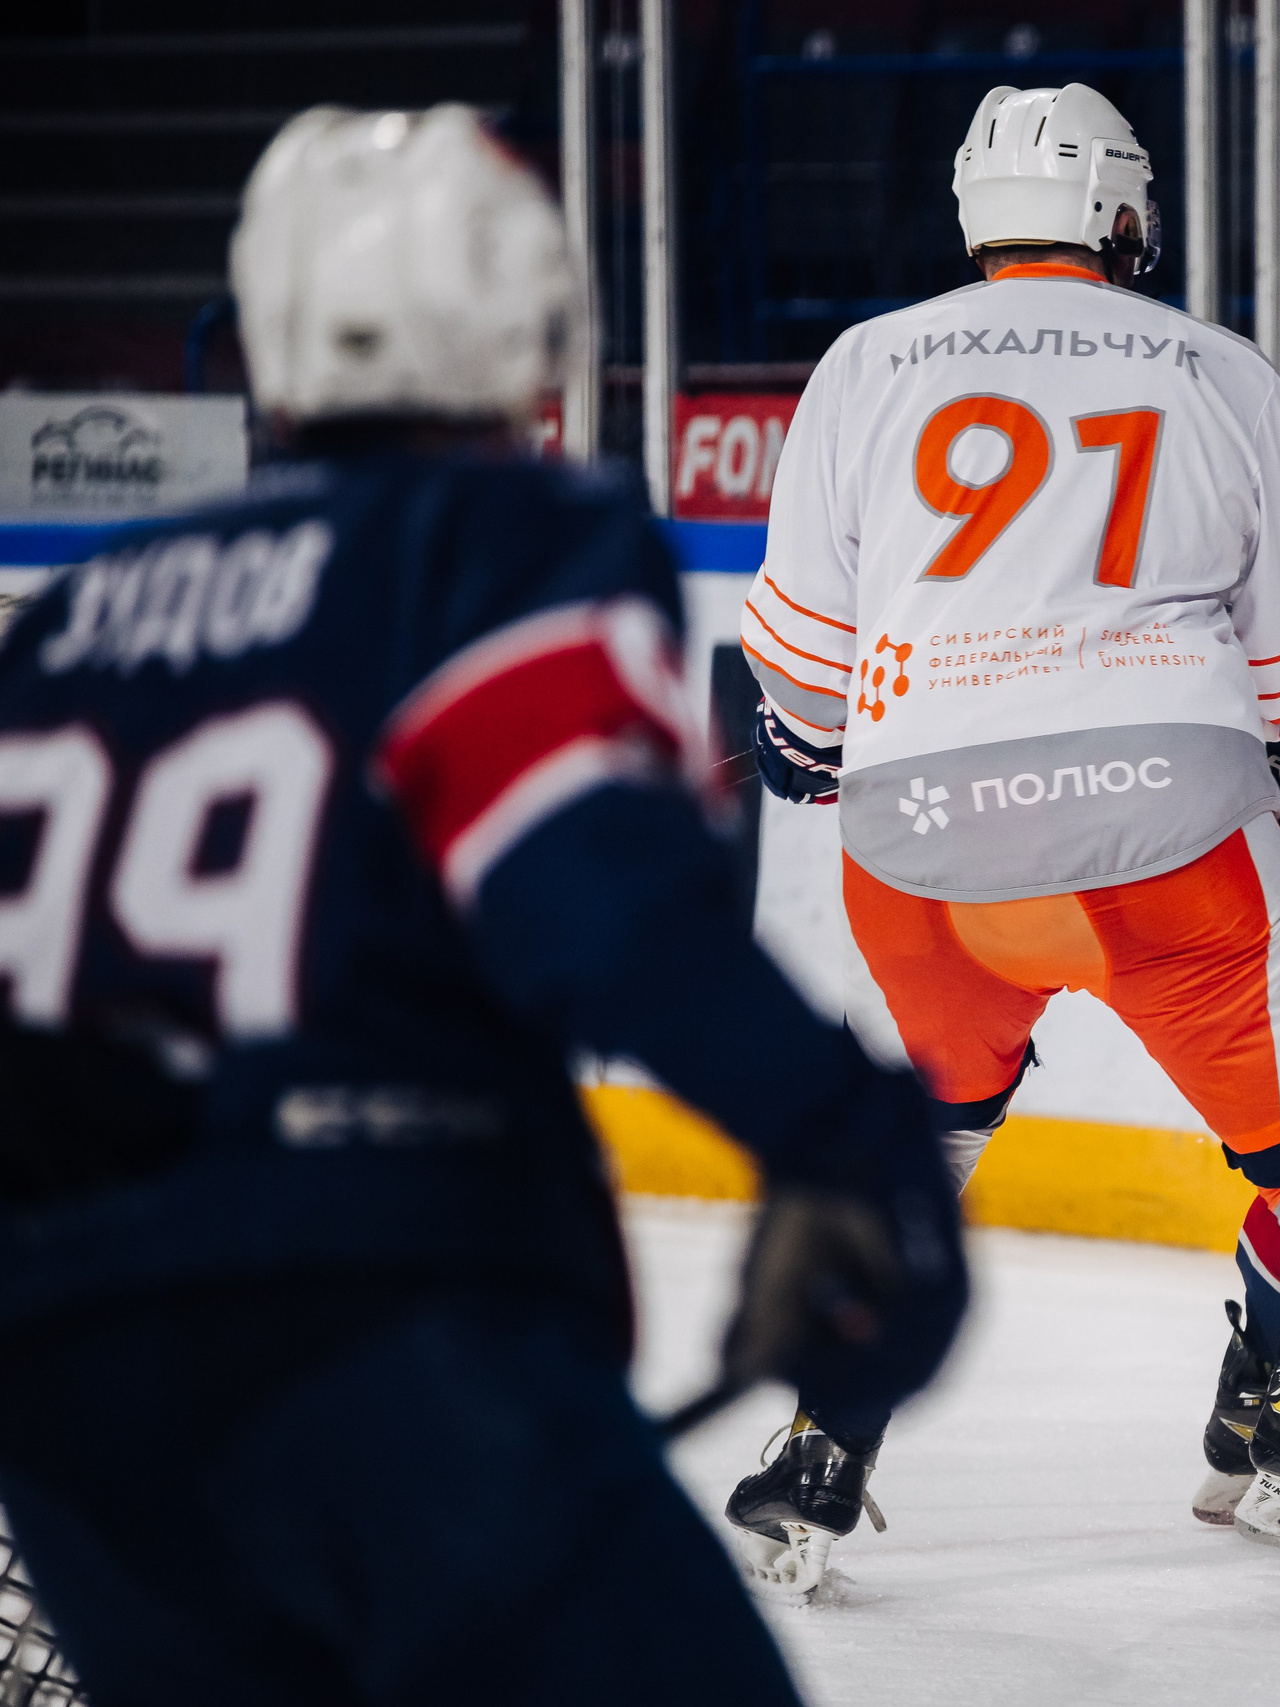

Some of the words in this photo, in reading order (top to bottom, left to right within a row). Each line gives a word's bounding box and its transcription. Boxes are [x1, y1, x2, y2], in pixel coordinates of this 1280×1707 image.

[890, 328, 1201, 381] МИХАЛЬЧУК
[929, 624, 1065, 647] СИБИРСКИЙ
[1100, 654, 1206, 668] UNIVERSITY
[971, 757, 1173, 813] ПОЛЮС
